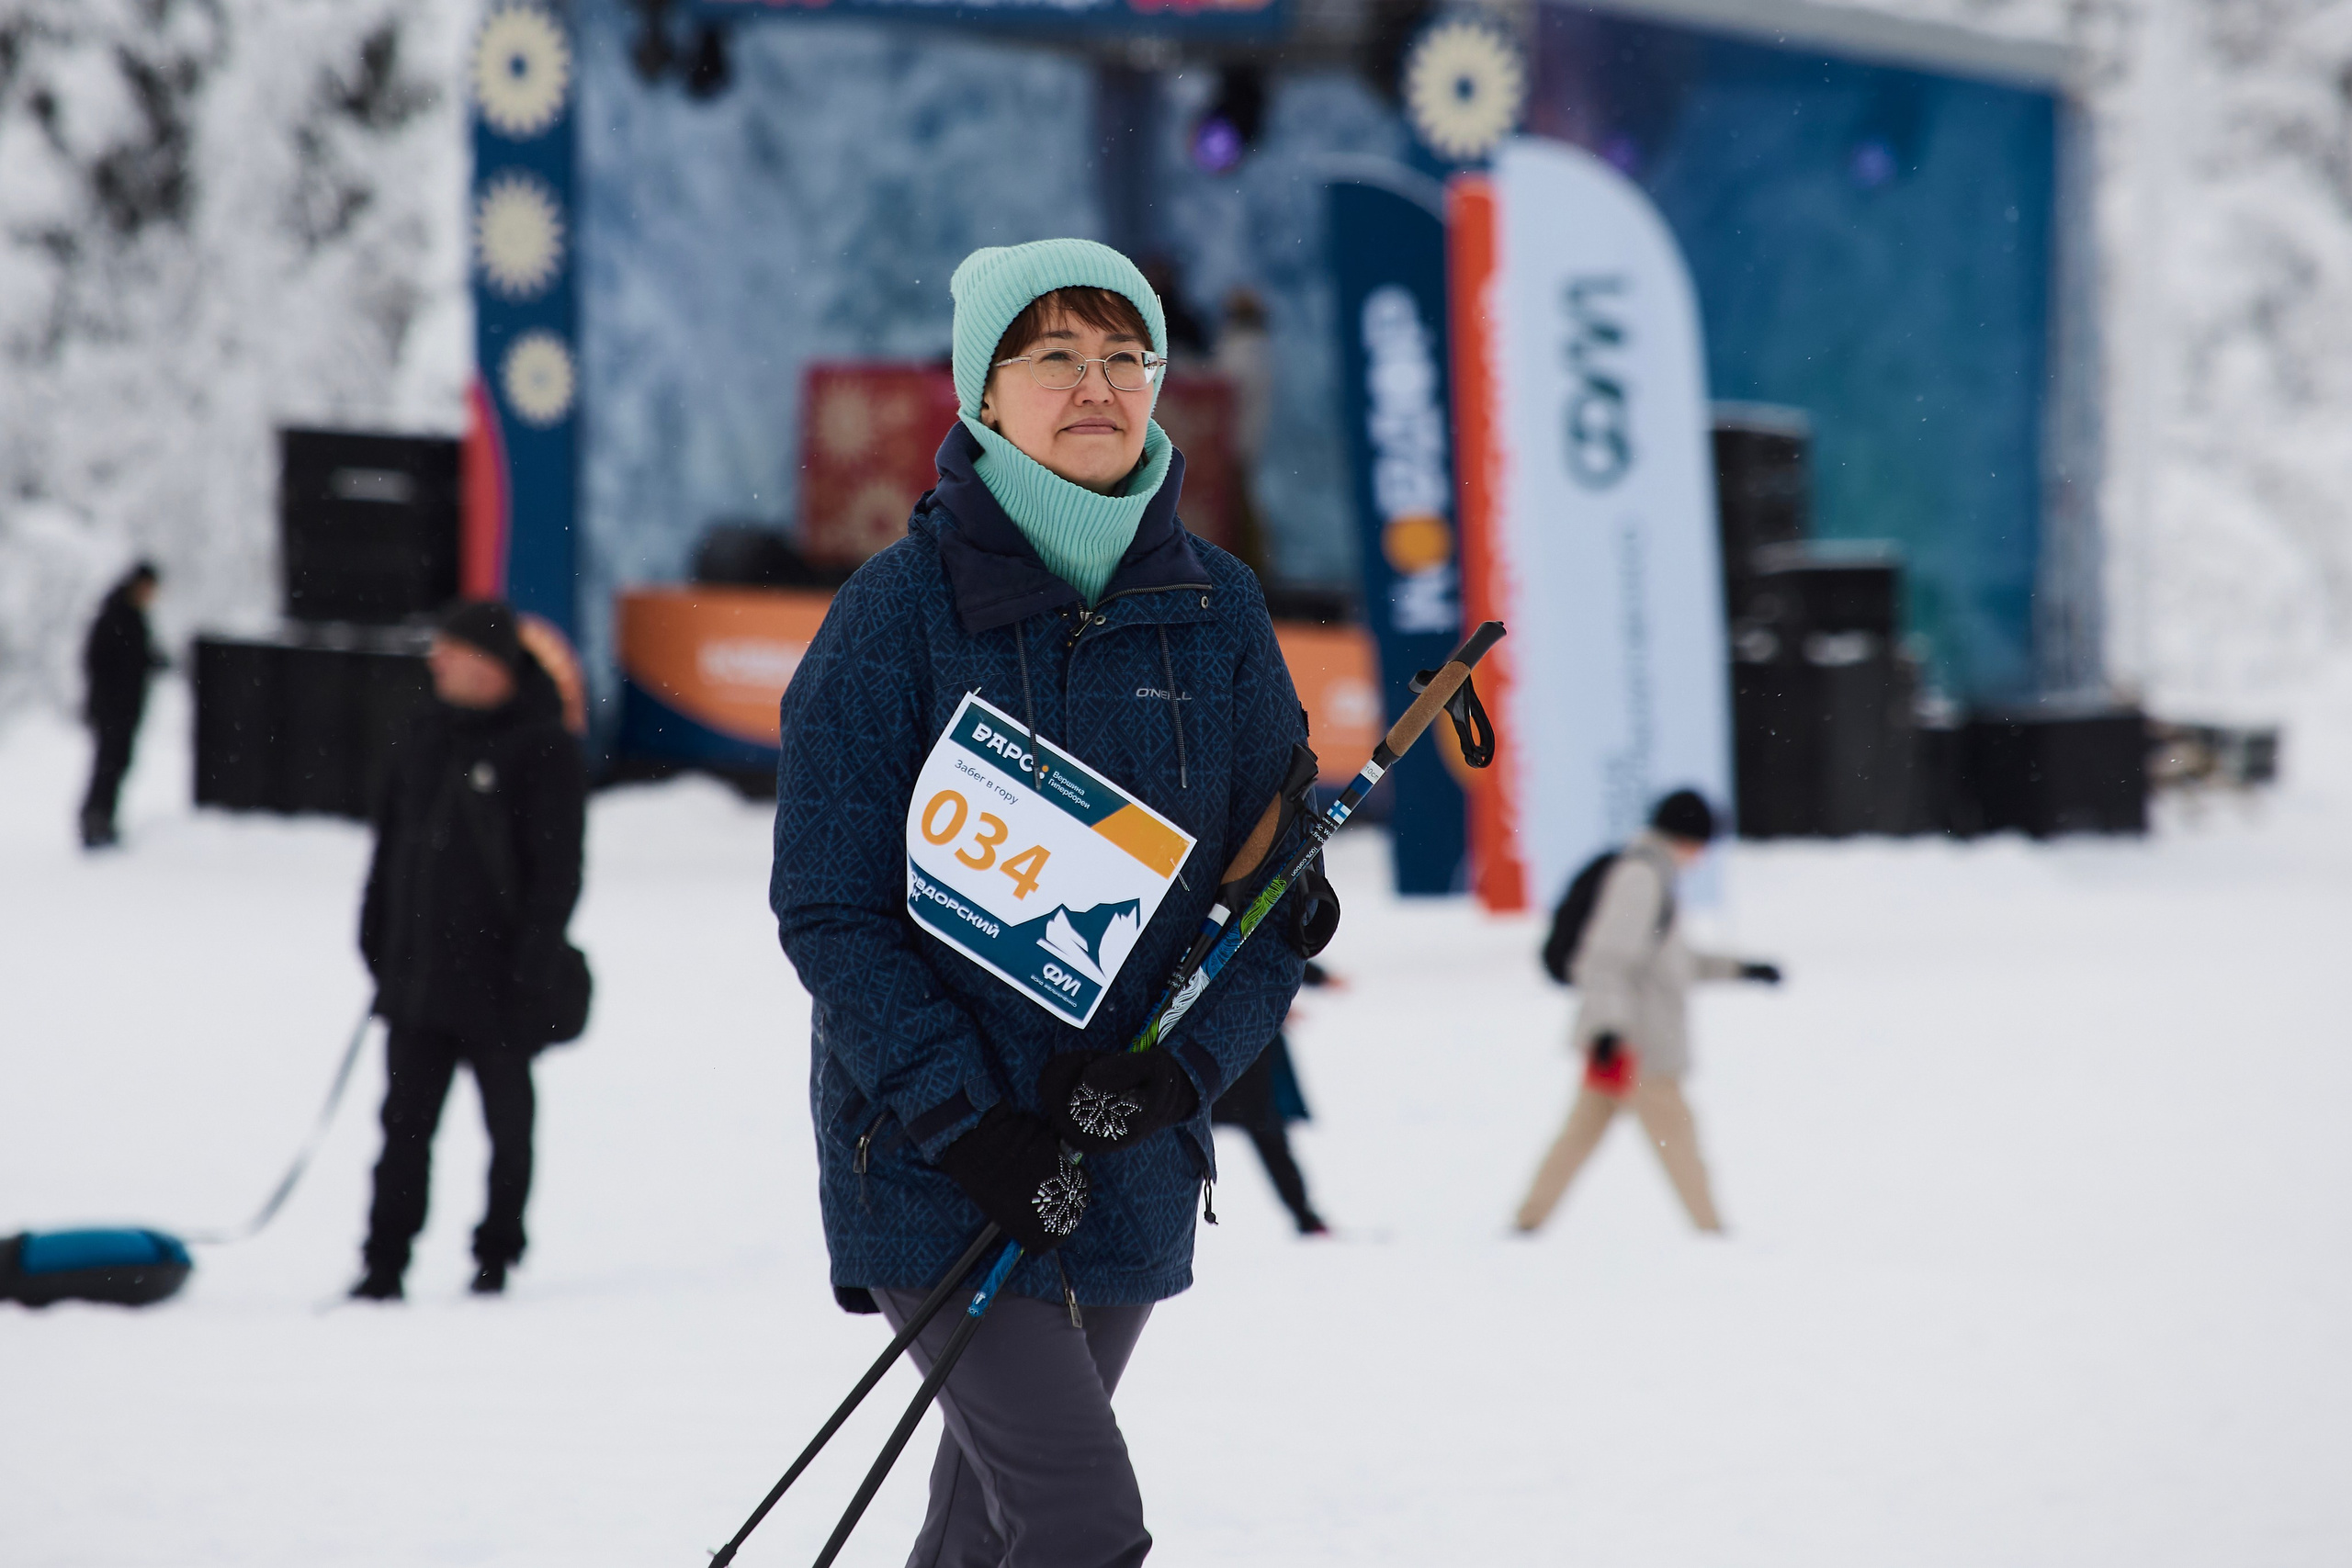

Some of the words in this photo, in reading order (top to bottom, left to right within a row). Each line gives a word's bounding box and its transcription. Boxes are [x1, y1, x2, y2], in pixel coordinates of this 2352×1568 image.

[955, 759, 987, 783] Забег
[986, 780, 994, 789] в
[994, 784, 1019, 806] гору
[1047, 778, 1091, 810] Гипербореи
[1052, 771, 1085, 796] Вершина
[921, 789, 1052, 901] 034
[1291, 858, 1307, 877] carbon
